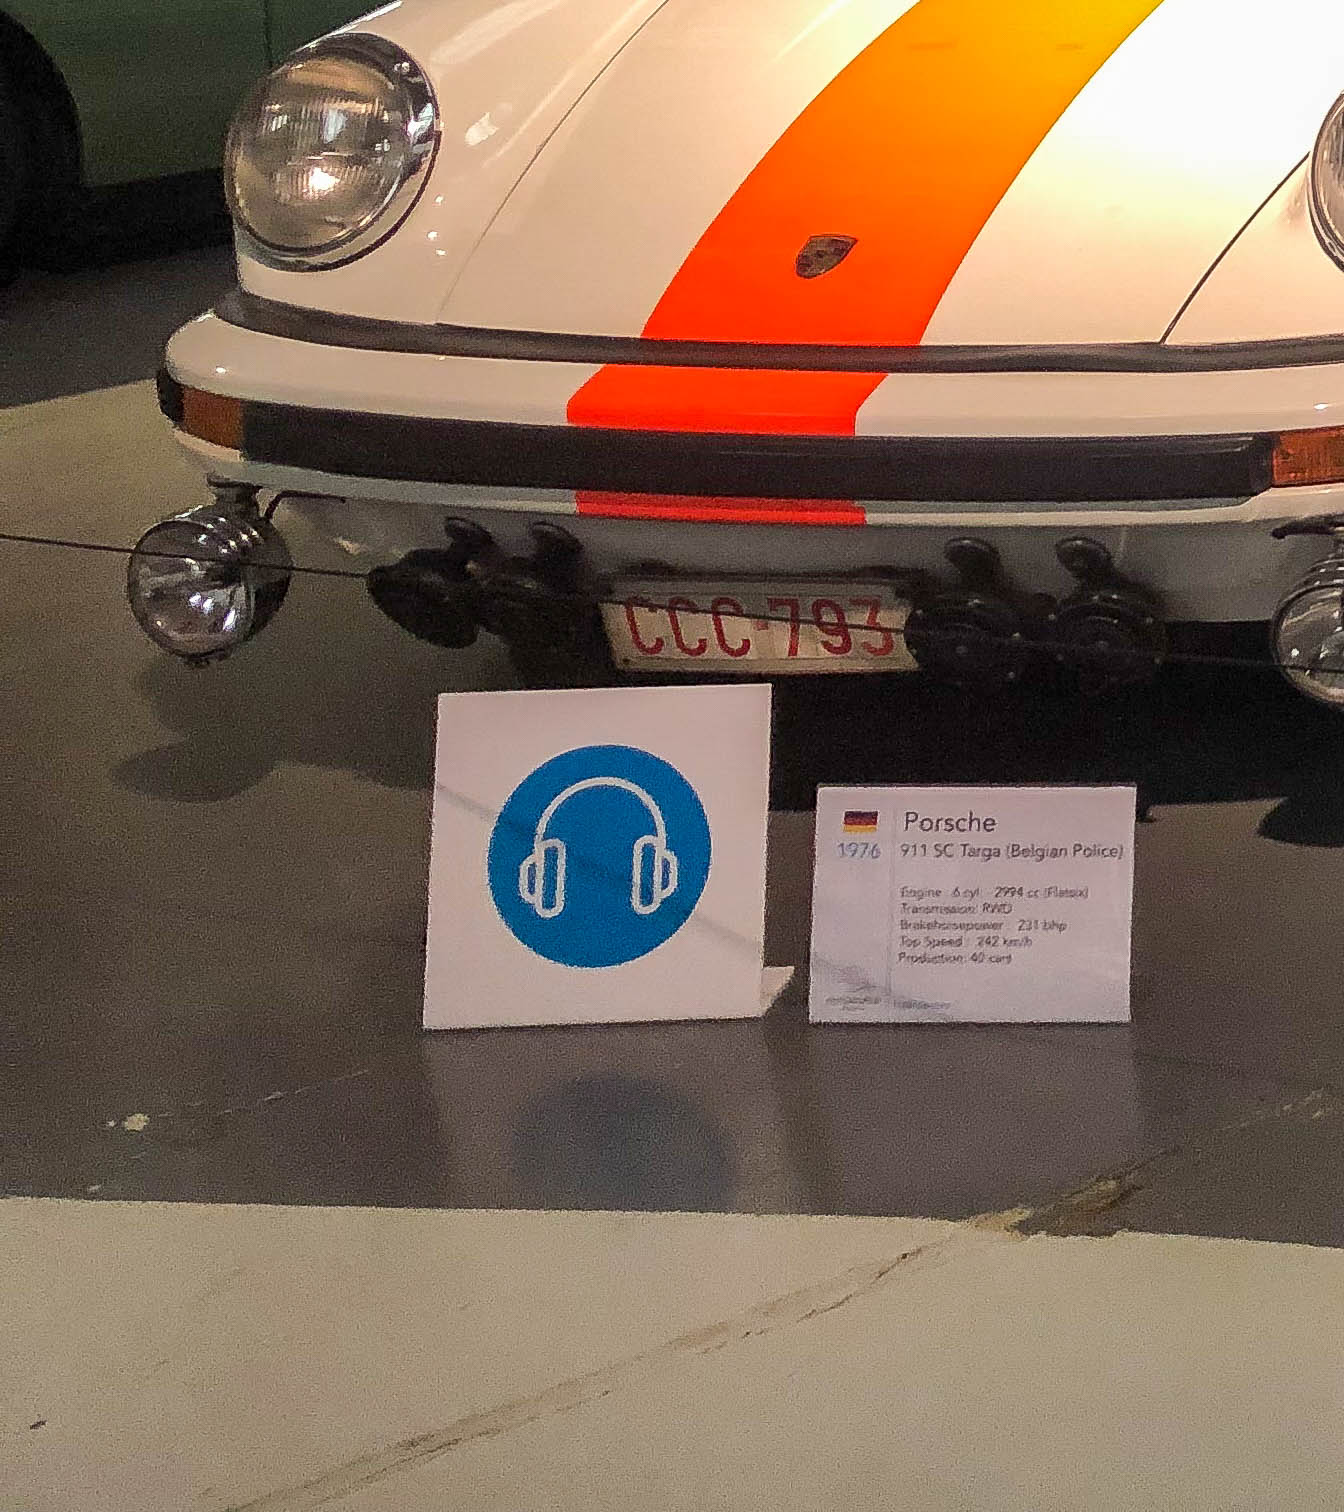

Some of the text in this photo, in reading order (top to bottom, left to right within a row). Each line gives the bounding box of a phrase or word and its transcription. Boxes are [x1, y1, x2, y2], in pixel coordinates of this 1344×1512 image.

[625, 594, 895, 658] CCC-793
[904, 810, 998, 833] Porsche
[836, 841, 1124, 863] 1976 911 SC Targa (Belgian Police)
